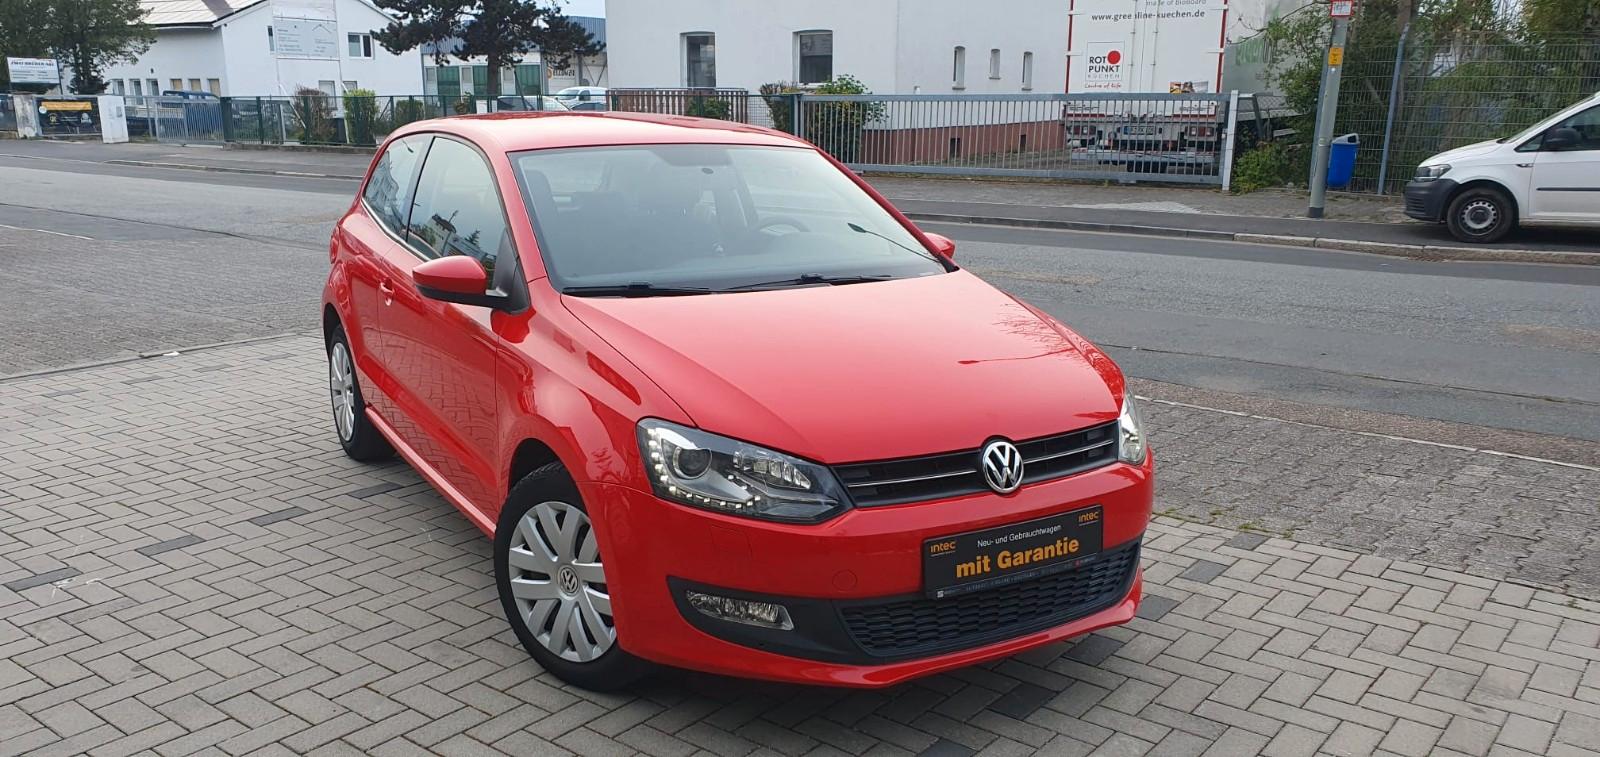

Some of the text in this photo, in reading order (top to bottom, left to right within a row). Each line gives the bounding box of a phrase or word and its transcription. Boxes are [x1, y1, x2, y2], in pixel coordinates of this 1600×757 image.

[1089, 56, 1106, 64] ROT
[1088, 65, 1120, 73] PUNKT
[1078, 511, 1099, 522] intec
[977, 524, 1062, 548] Neu- und Gebrauchtwagen
[930, 541, 957, 553] intec
[956, 555, 991, 578] mit
[997, 537, 1080, 569] Garantie
